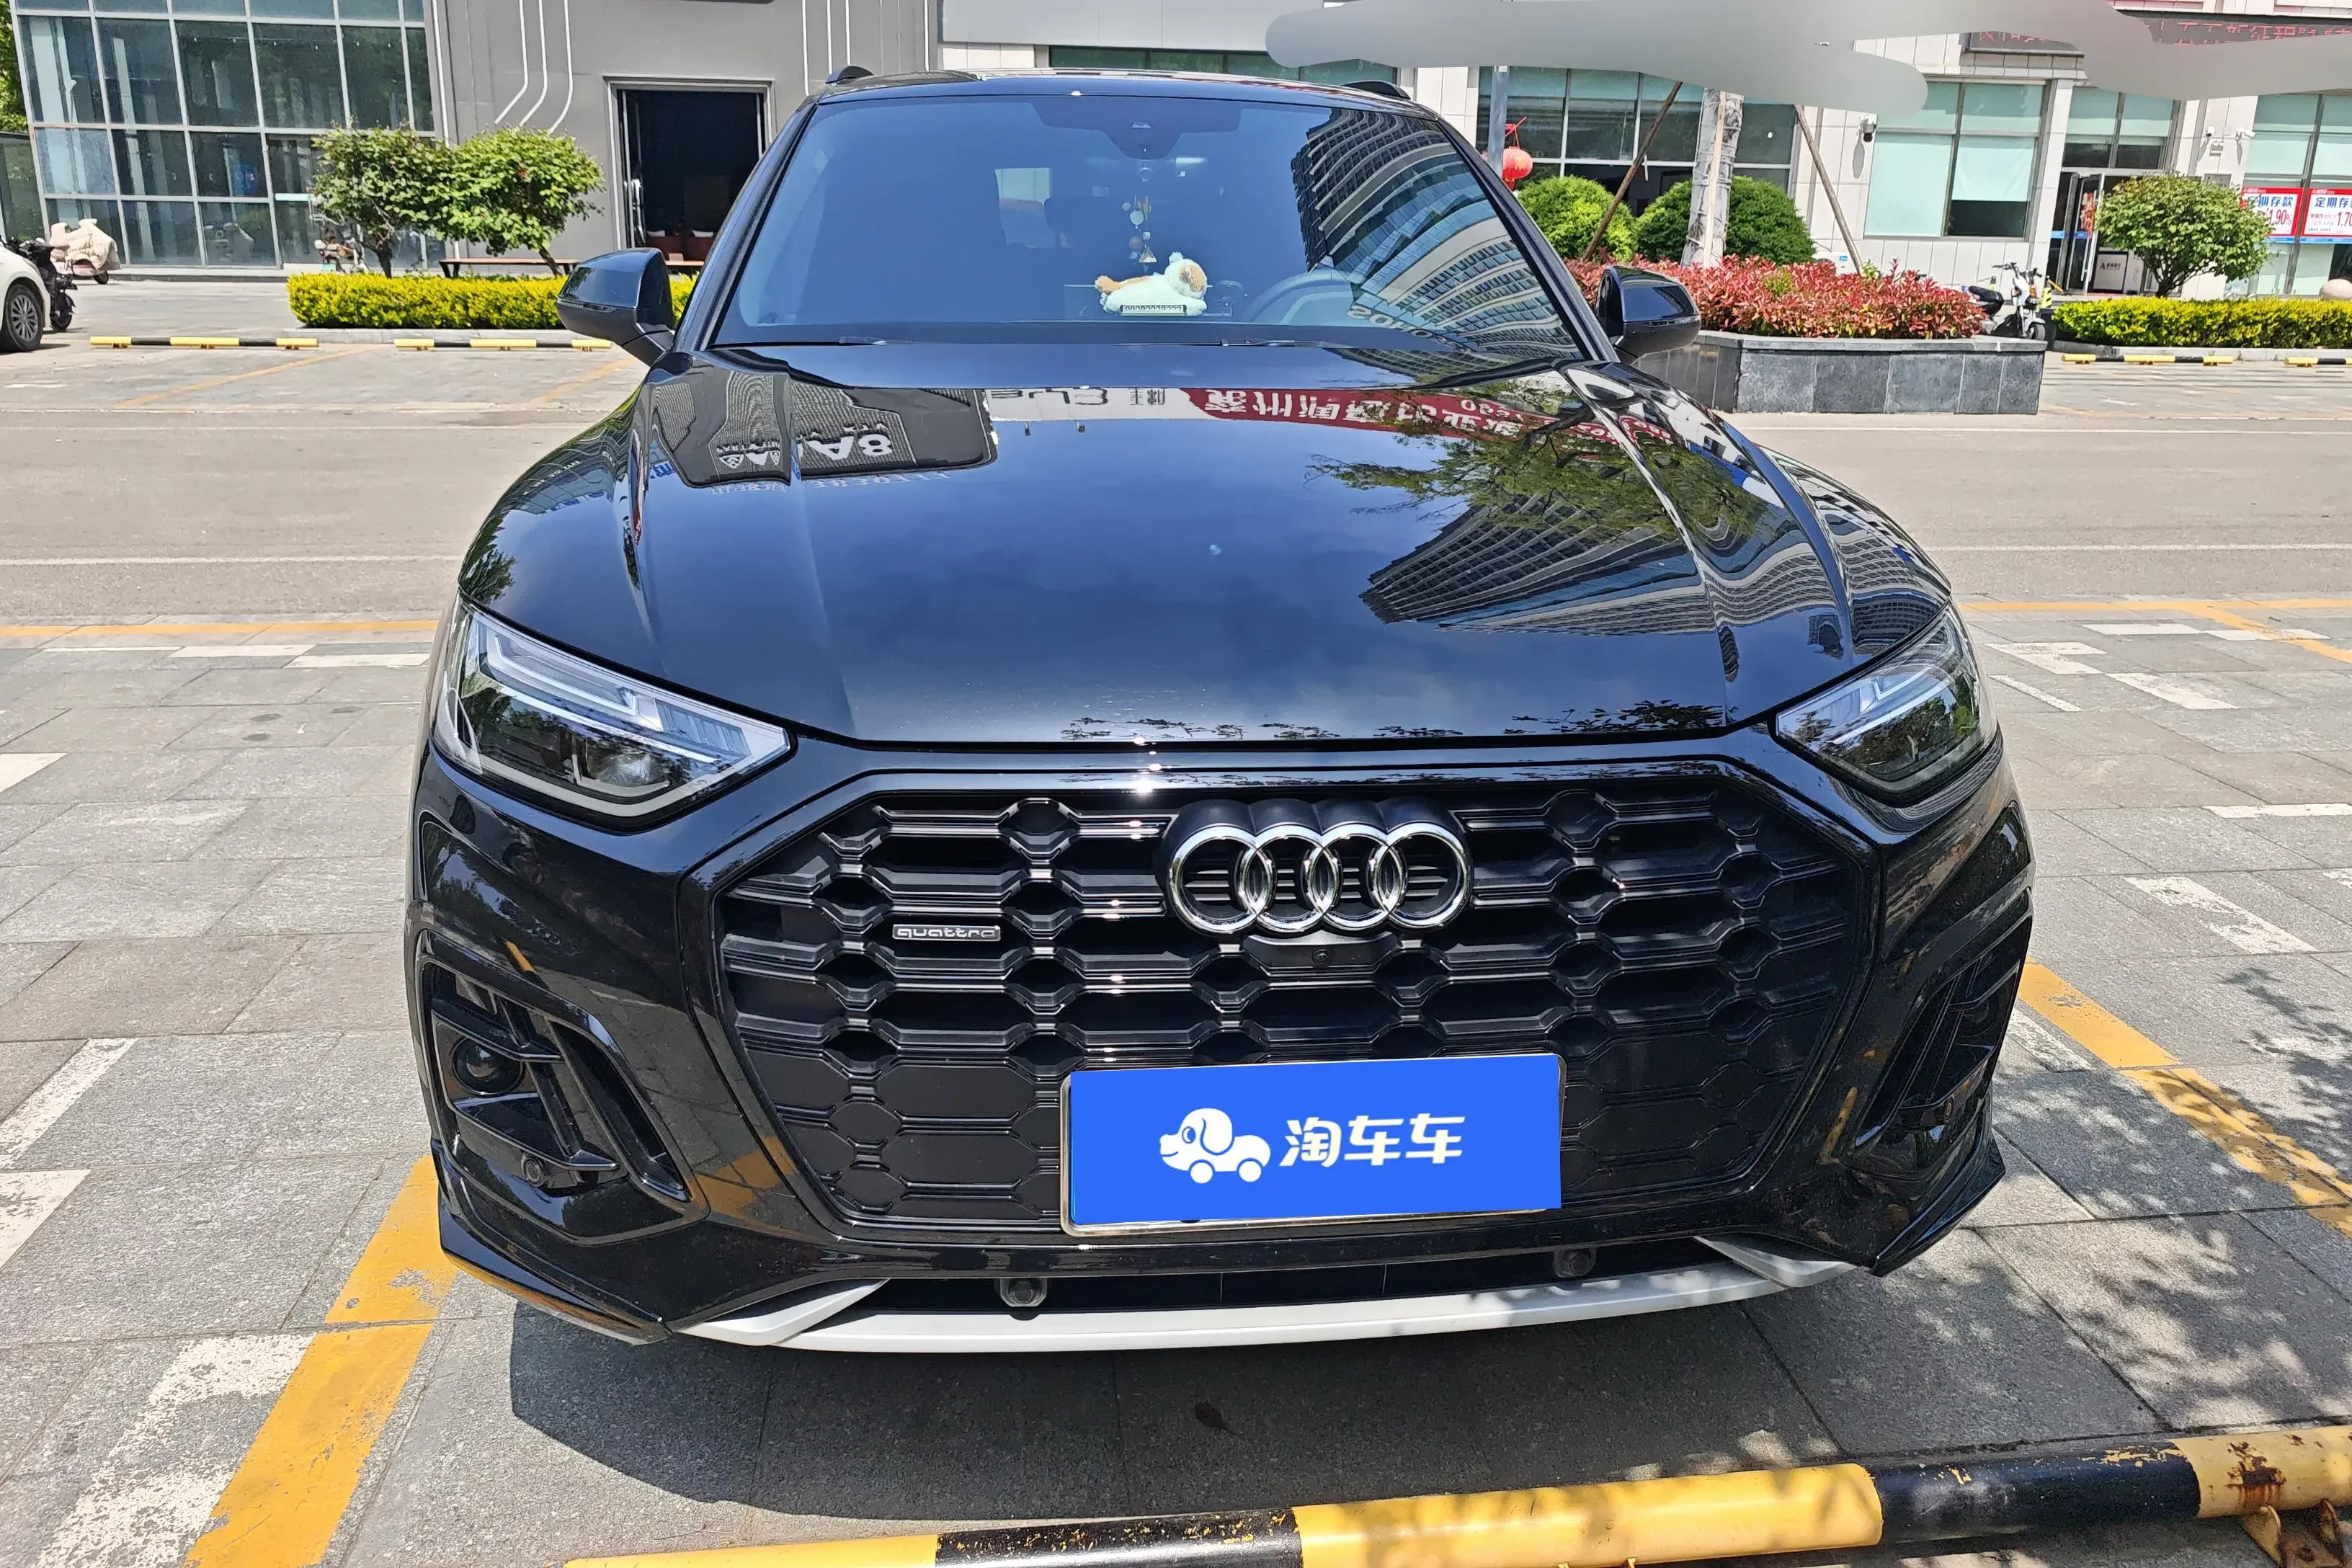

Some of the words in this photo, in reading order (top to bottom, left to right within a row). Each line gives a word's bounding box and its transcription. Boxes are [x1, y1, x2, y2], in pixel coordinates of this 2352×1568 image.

[2315, 197, 2352, 208] 定期存
[897, 927, 995, 938] quattro
